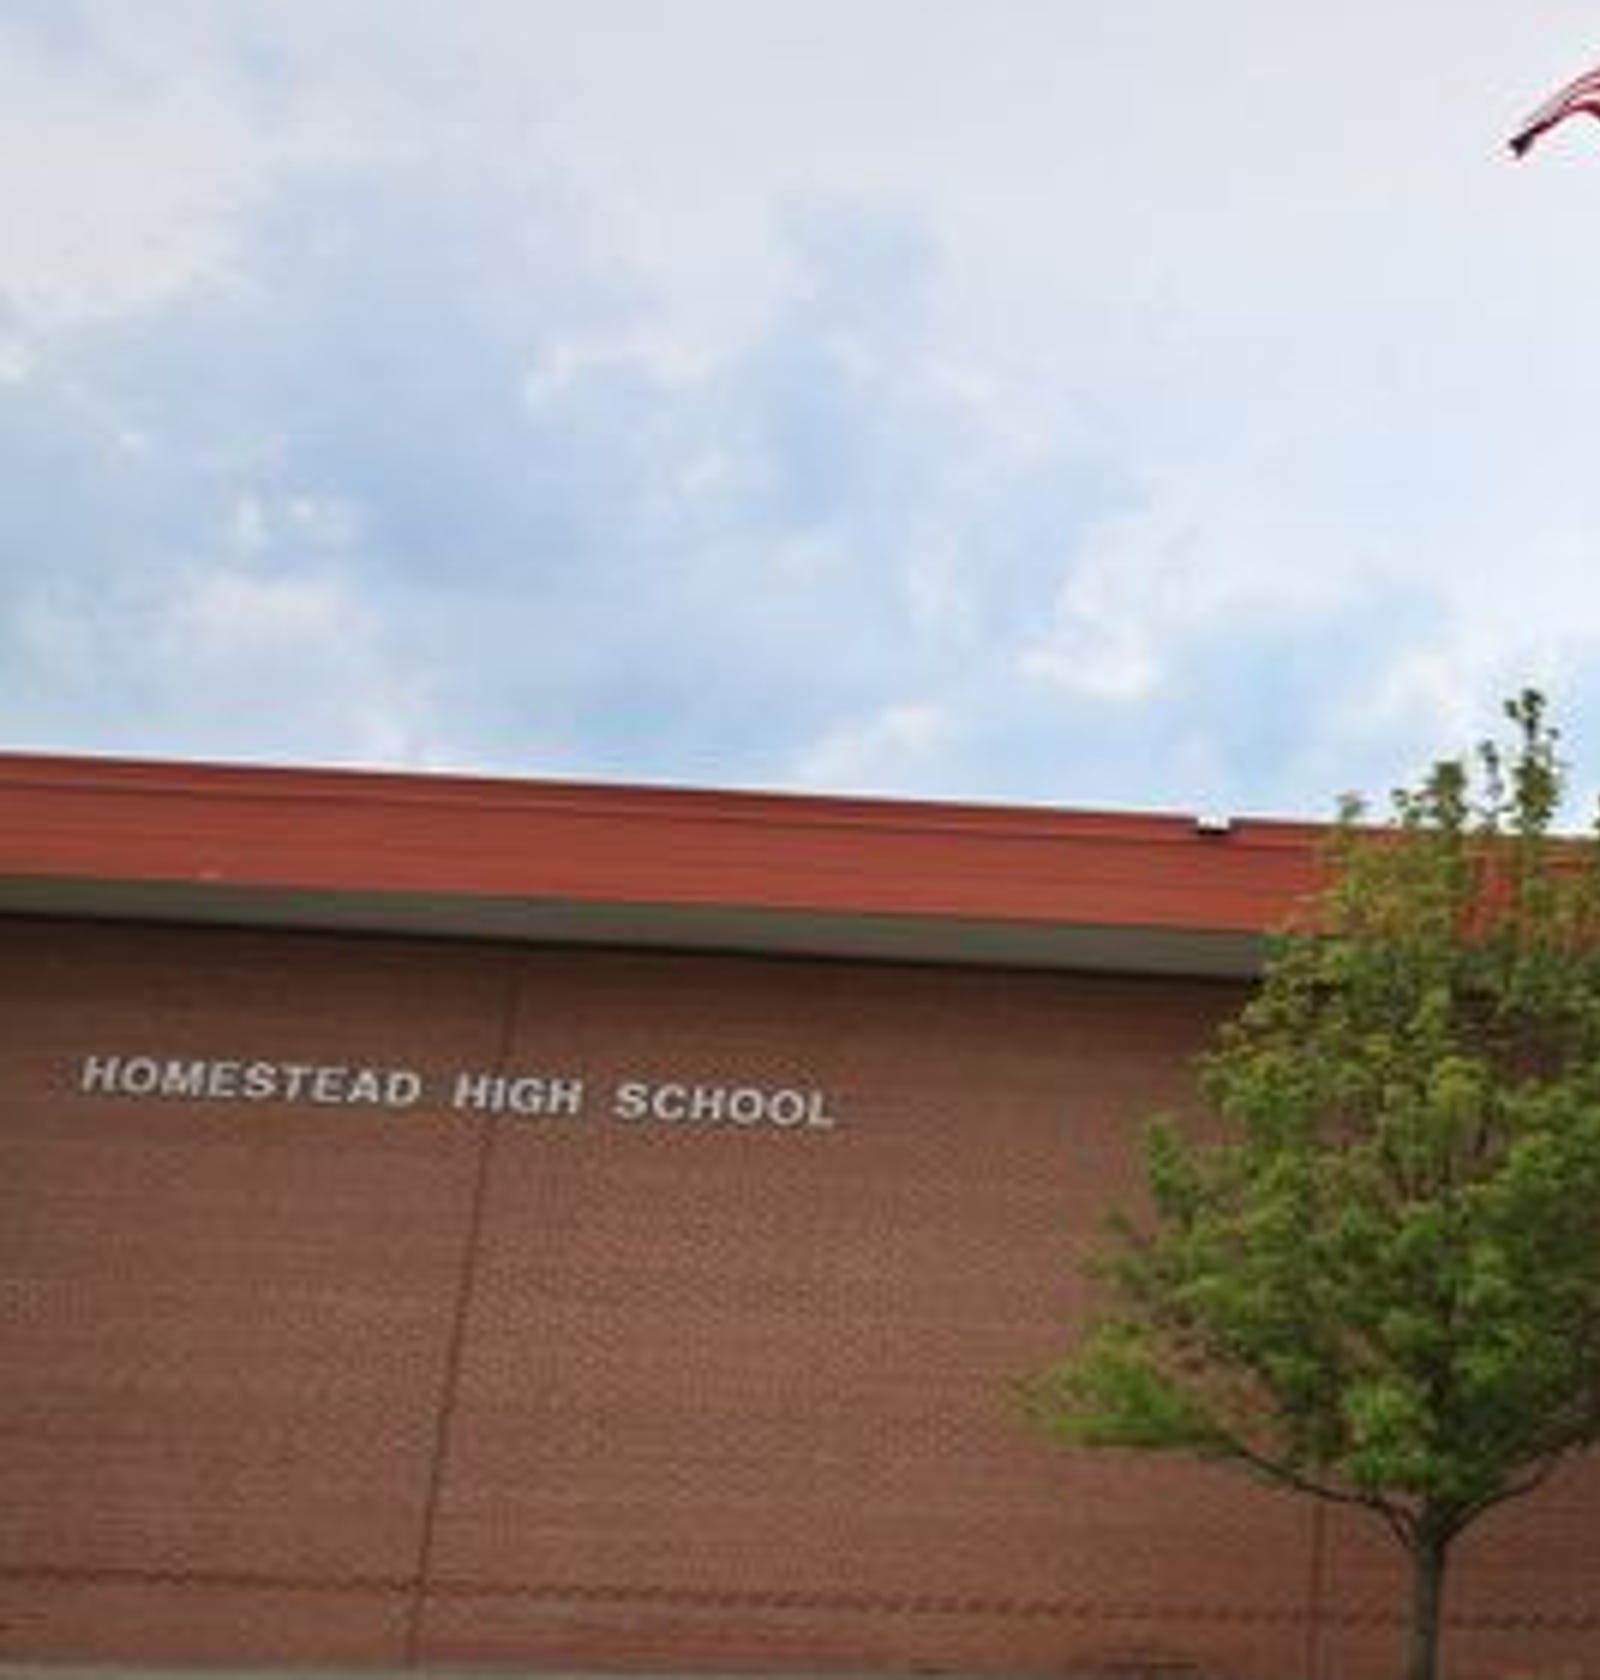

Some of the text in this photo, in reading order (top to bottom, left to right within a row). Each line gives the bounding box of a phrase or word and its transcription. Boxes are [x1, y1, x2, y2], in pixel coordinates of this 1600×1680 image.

[81, 1055, 834, 1128] HOMESTEAD HIGH SCHOOL
